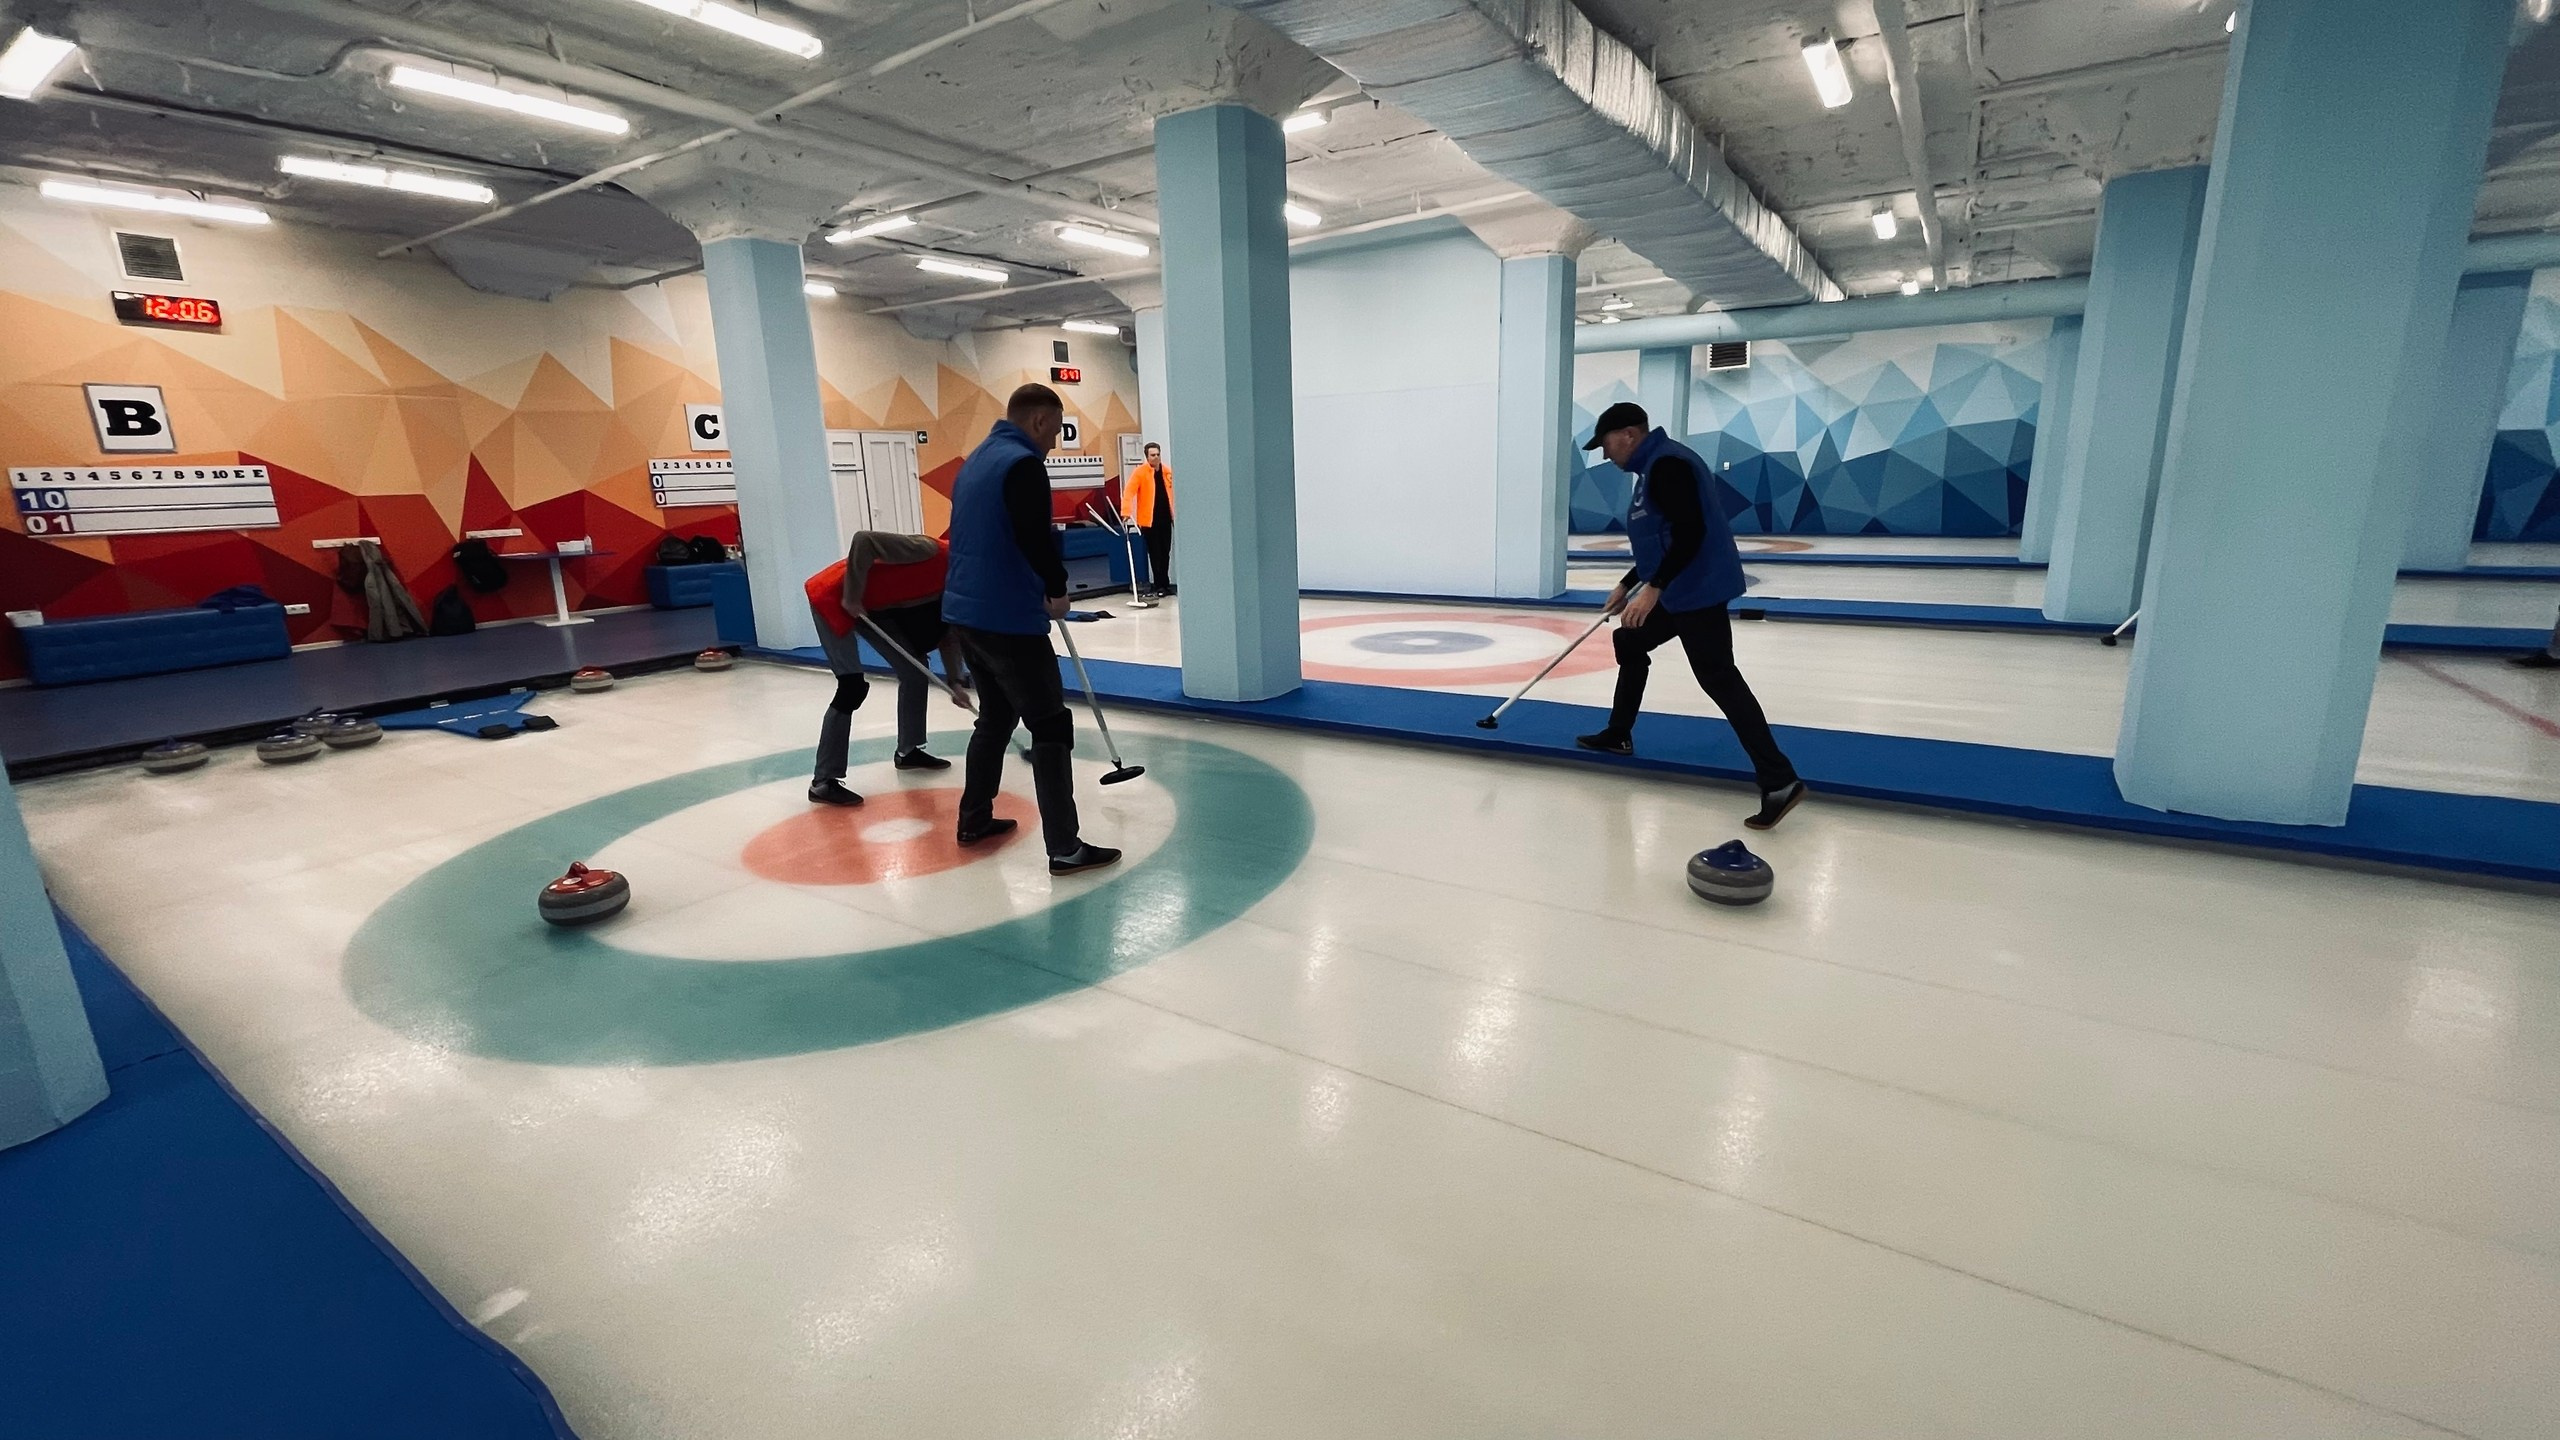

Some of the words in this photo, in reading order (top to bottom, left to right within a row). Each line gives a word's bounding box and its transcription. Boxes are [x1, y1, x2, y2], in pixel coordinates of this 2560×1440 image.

[98, 399, 162, 436] B
[694, 413, 720, 440] C
[1062, 423, 1077, 441] D
[685, 461, 691, 469] 4
[17, 472, 28, 482] 1
[40, 471, 53, 482] 2
[63, 471, 76, 481] 3
[87, 471, 100, 481] 4
[109, 471, 122, 480] 5
[131, 470, 143, 480] 6
[152, 470, 163, 480] 7
[174, 470, 185, 480] 8
[194, 470, 205, 479] 9
[212, 469, 229, 479] 10
[233, 469, 245, 479] E
[252, 469, 264, 478] E
[652, 475, 662, 488] 0
[655, 492, 666, 504] 0
